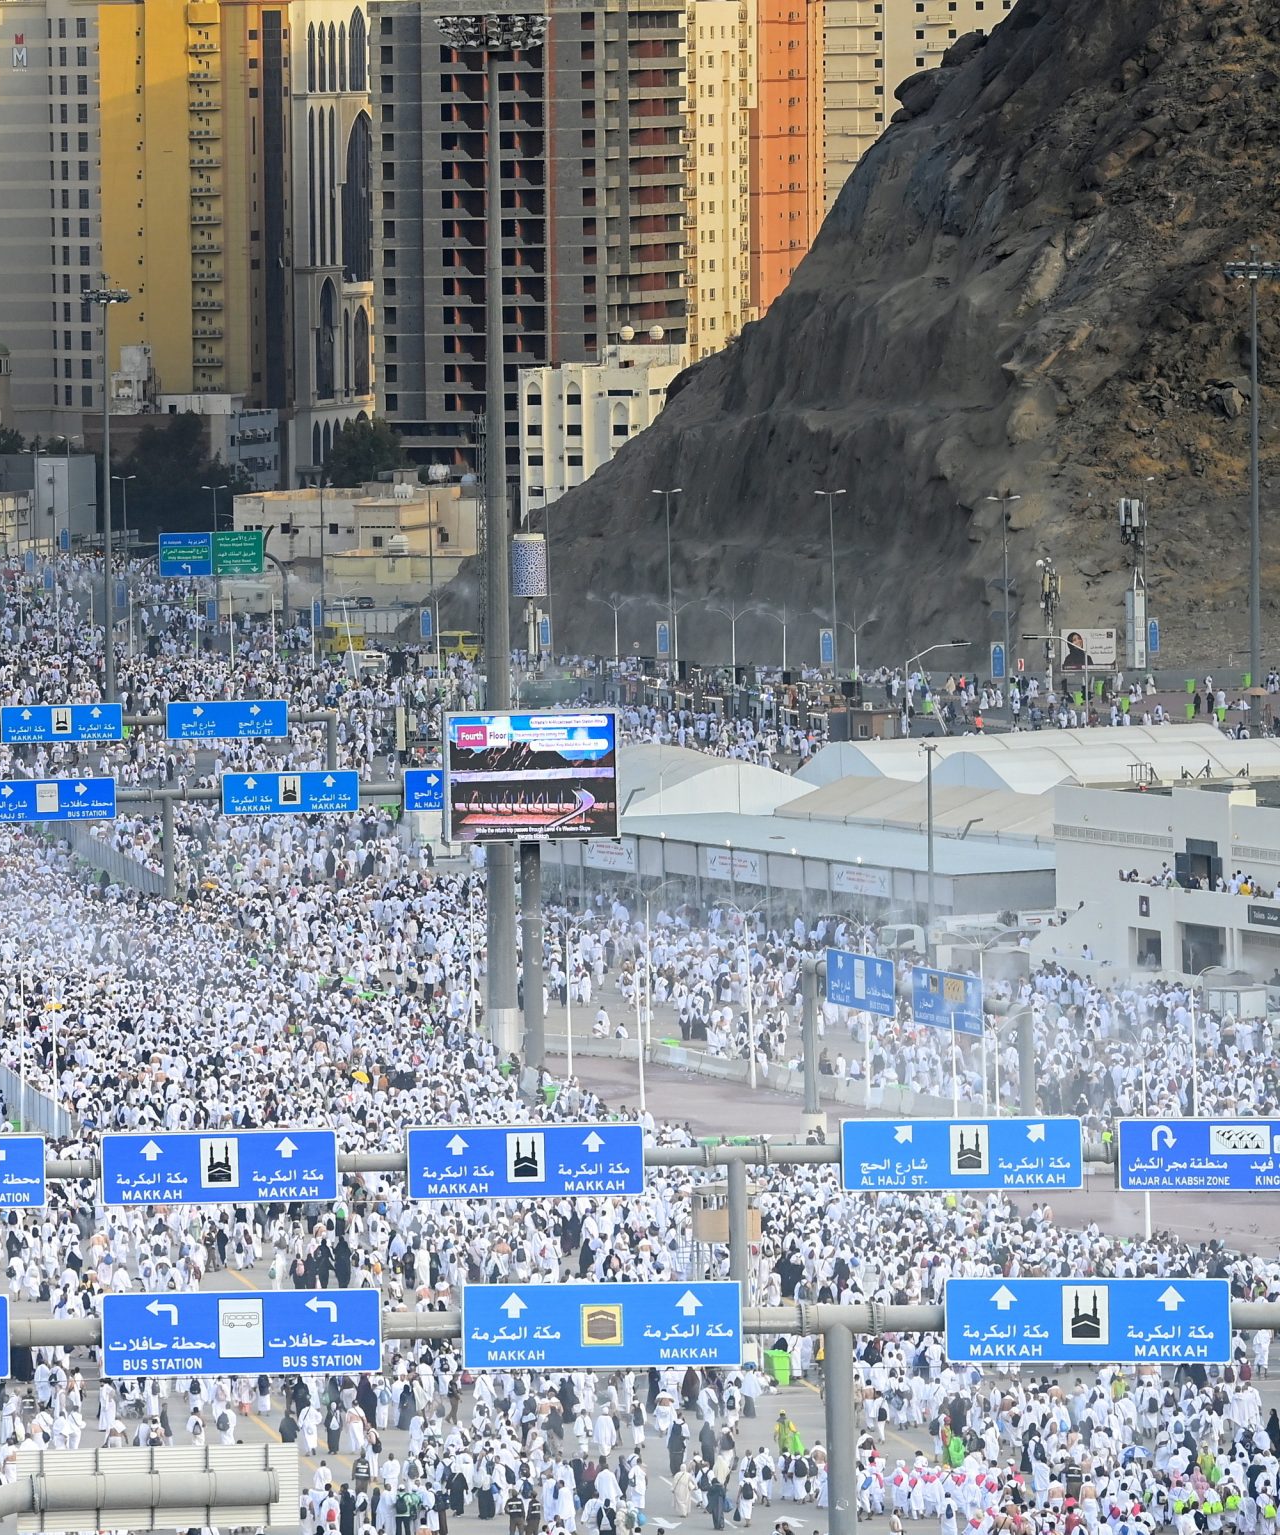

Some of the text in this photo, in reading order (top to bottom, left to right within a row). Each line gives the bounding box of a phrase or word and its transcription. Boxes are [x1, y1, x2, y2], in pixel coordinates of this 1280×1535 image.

[461, 732, 483, 740] Fourth
[489, 732, 506, 740] Floor
[861, 1158, 928, 1175] شارع الحج
[999, 1157, 1070, 1171] مكة المكرمة
[1129, 1157, 1227, 1172] منطقة مجر الكبش
[1251, 1157, 1273, 1172] فهد
[253, 1169, 323, 1184] مكة المكرمة
[423, 1166, 494, 1180] مكة المكرمة
[558, 1163, 630, 1178] مكة المكرمة
[3, 1174, 40, 1184] محطة
[117, 1173, 188, 1187] مكة المكرمة
[861, 1175, 927, 1185] AL HAJJ ST.
[1004, 1174, 1065, 1184] MAKKAH
[1129, 1176, 1229, 1185] MAJAR AL KABSH ZONE
[428, 1183, 488, 1193] MAKKAH
[565, 1180, 624, 1191] MAKKAH
[123, 1190, 182, 1200] MAKKAH
[259, 1187, 318, 1197] MAKKAH
[472, 1326, 560, 1343] مكة المكرمة
[644, 1324, 733, 1341] مكة المكرمة
[963, 1325, 1049, 1341] مكة المكرمة
[1127, 1325, 1214, 1341] مكة المكرمة
[109, 1337, 216, 1351] محطة حافلات
[269, 1333, 375, 1347] محطة حافلات
[488, 1351, 544, 1360] MAKKAH
[660, 1348, 717, 1358] MAKKAH
[970, 1344, 1042, 1356] MAKKAH
[1135, 1345, 1207, 1356] MAKKAH
[123, 1358, 202, 1370] BUS STATION
[283, 1355, 361, 1367] BUS STATION
